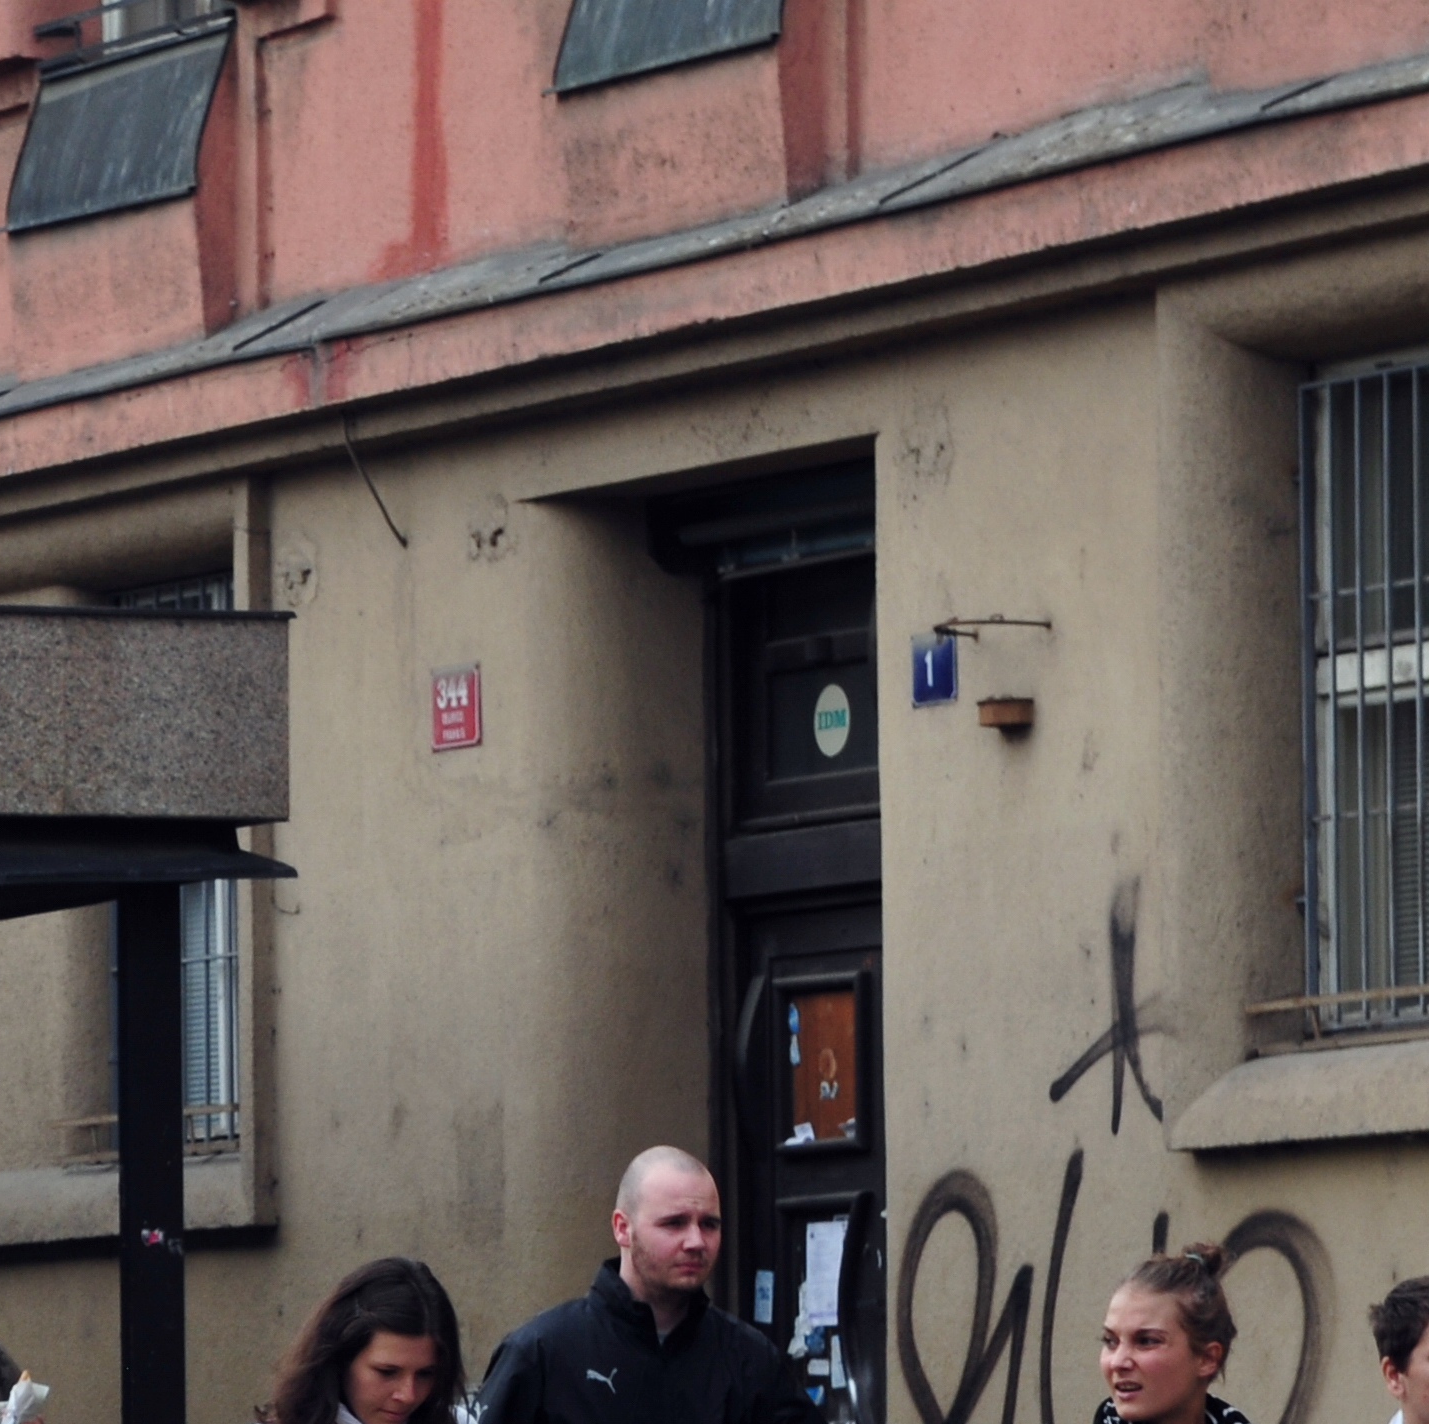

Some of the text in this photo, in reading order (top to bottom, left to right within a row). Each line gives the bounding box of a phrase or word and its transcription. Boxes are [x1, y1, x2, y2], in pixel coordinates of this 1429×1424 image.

[924, 650, 934, 687] 1
[437, 675, 469, 709] 344
[817, 709, 847, 731] IDM
